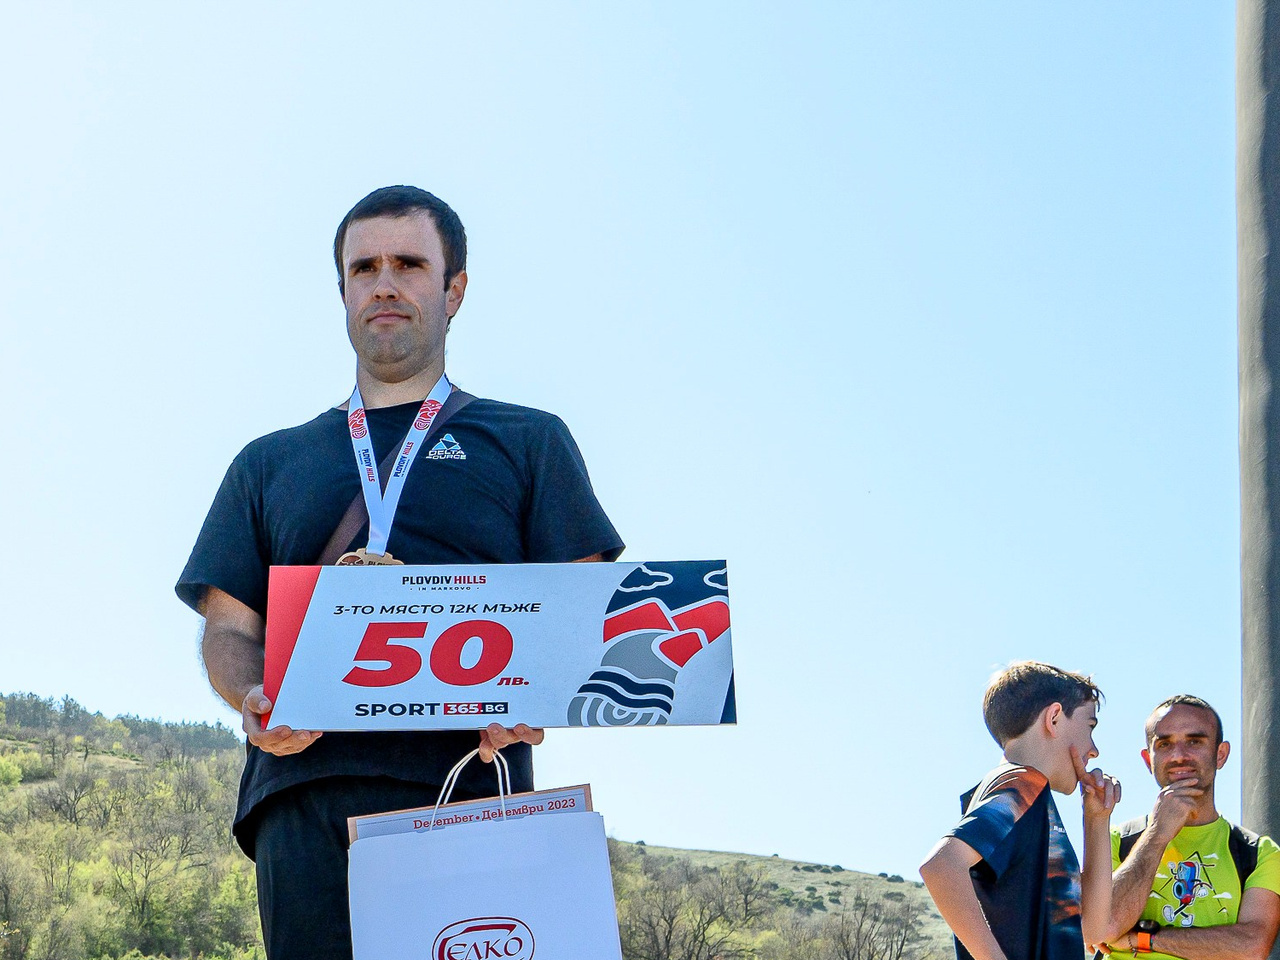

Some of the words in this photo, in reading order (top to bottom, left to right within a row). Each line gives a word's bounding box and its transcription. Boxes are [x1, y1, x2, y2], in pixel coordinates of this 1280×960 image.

[401, 575, 452, 585] PLOVDIV
[453, 575, 487, 584] HILLS
[333, 605, 375, 615] 3-ТО
[379, 604, 445, 615] МЯСТО
[449, 603, 479, 614] 12К
[482, 602, 542, 614] МЪЖЕ
[341, 619, 514, 688] 50
[354, 702, 441, 717] SPORT
[445, 702, 508, 715] 365.BG
[547, 798, 576, 811] 2023
